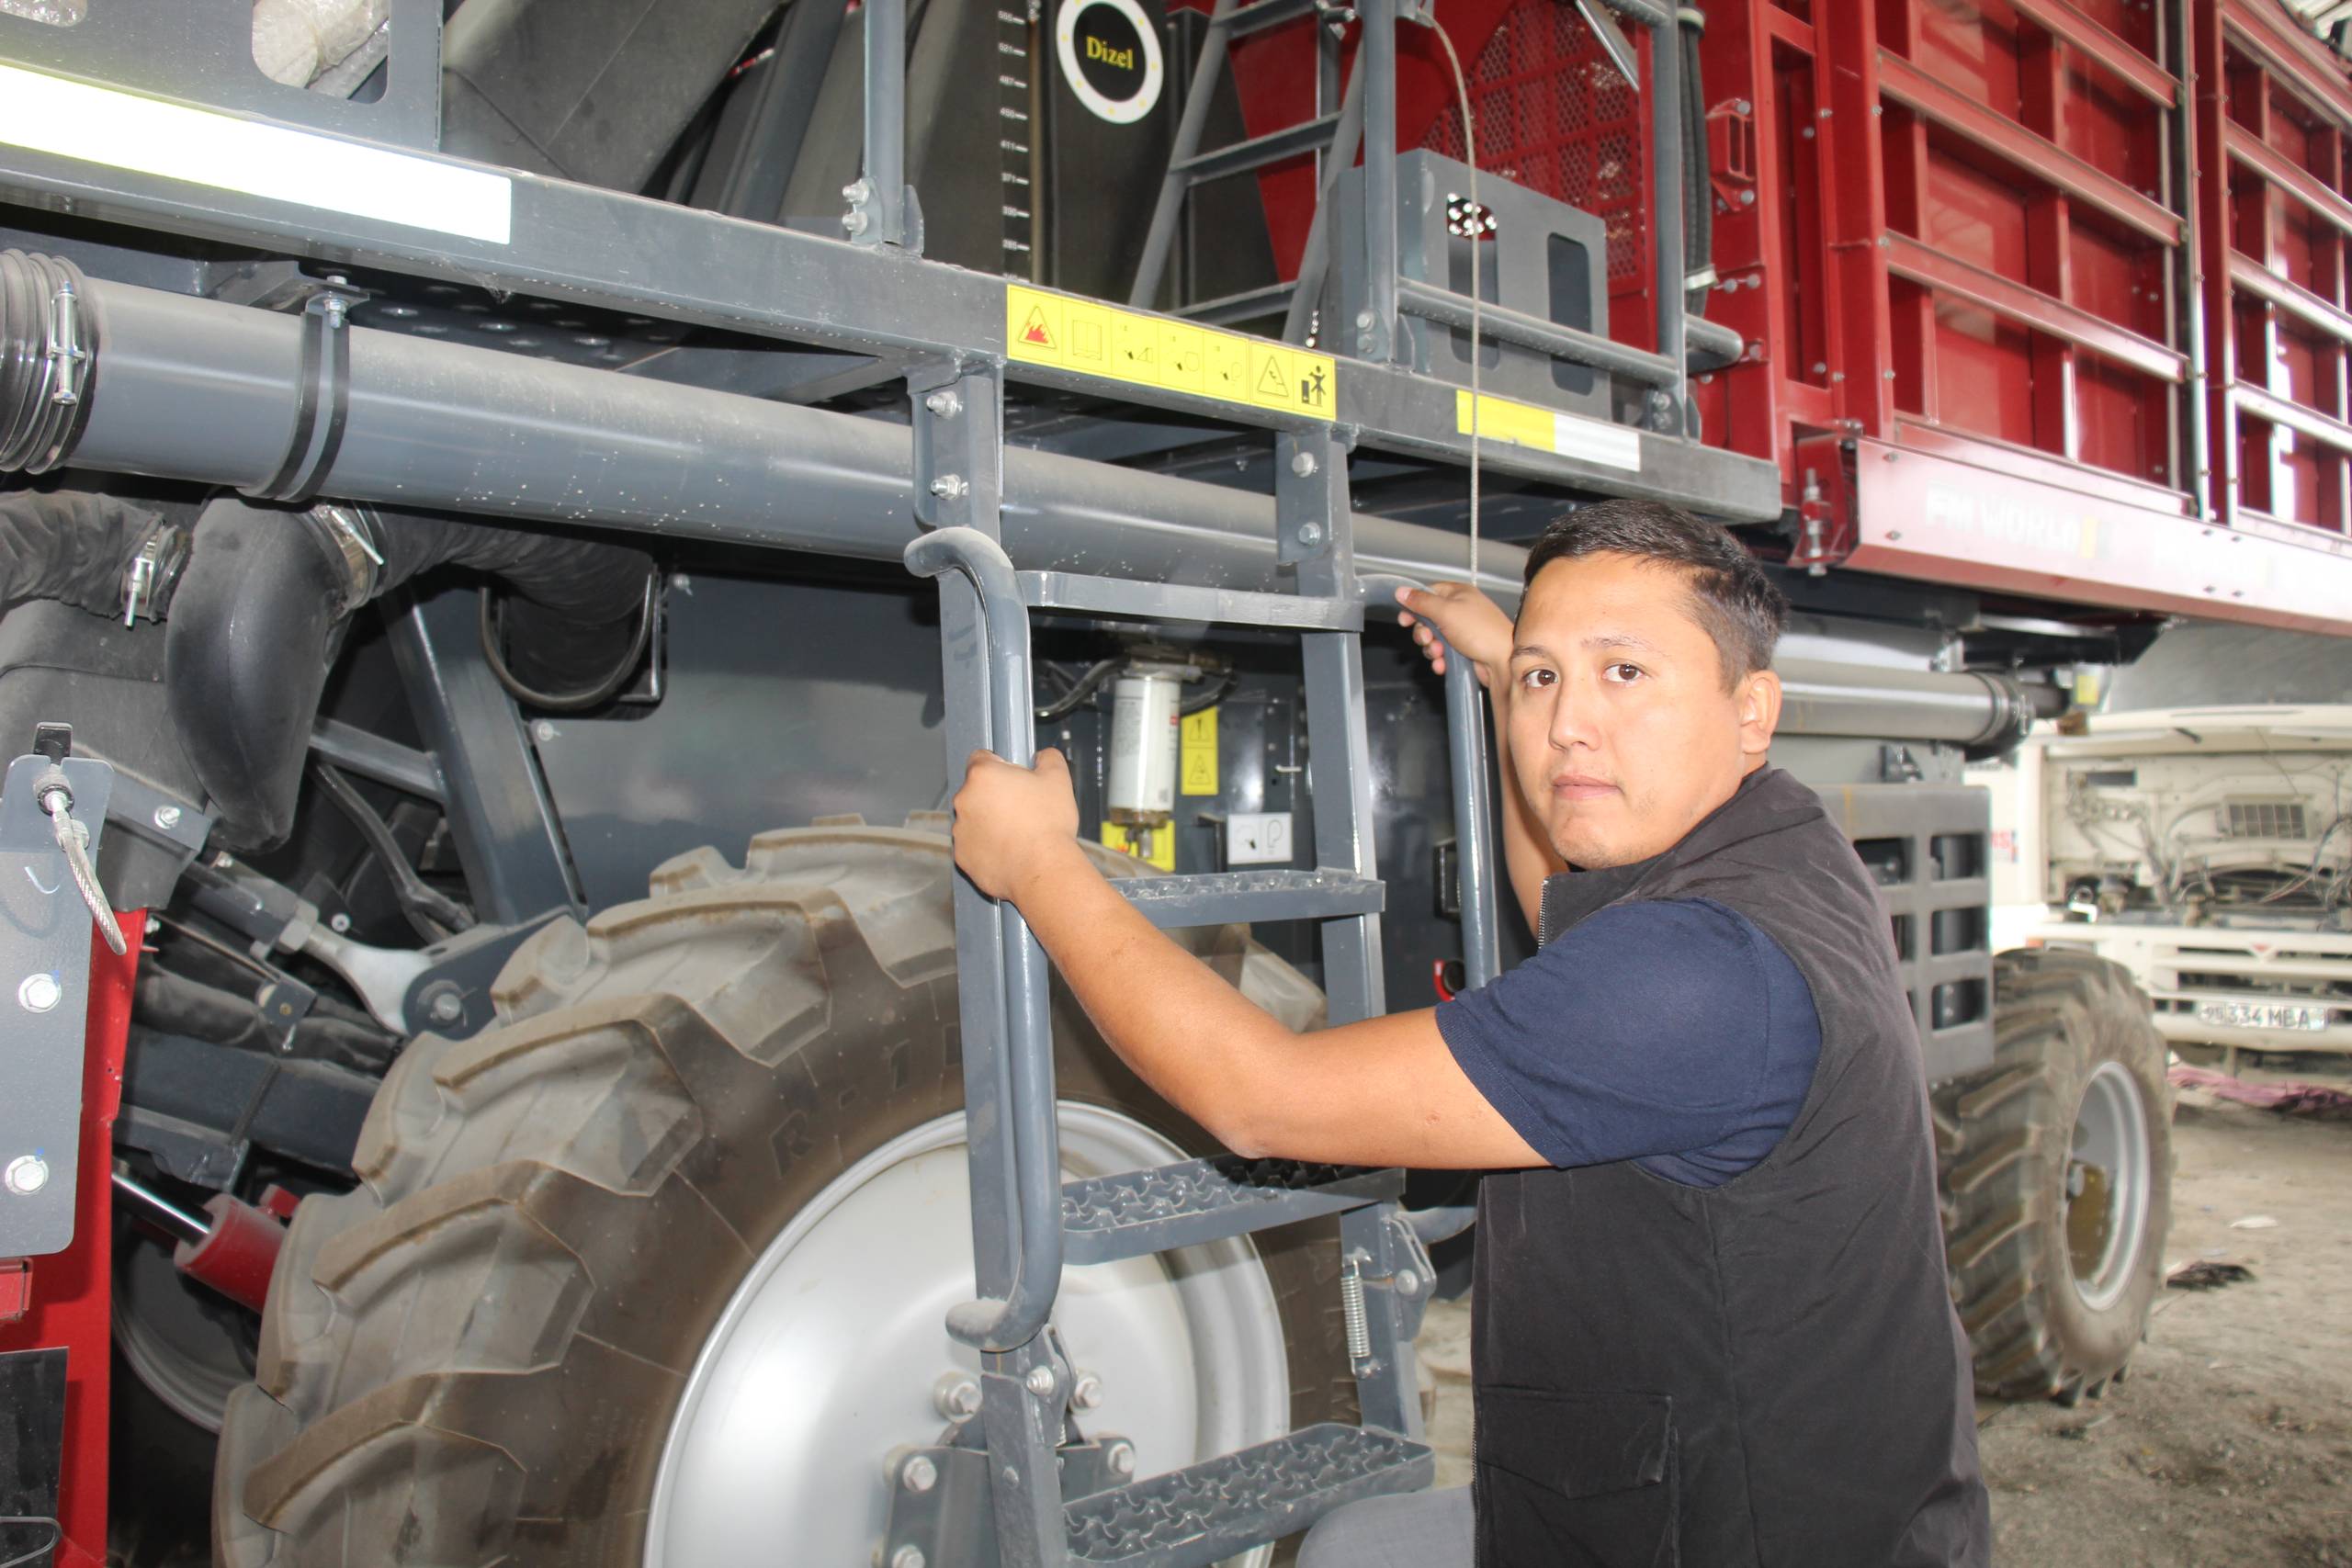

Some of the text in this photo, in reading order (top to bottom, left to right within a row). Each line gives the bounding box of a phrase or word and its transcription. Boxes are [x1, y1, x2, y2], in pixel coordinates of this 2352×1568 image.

[999, 42, 1013, 53] 521
[1086, 36, 1134, 70] Dizel
[1981, 492, 2080, 555] WORLD
